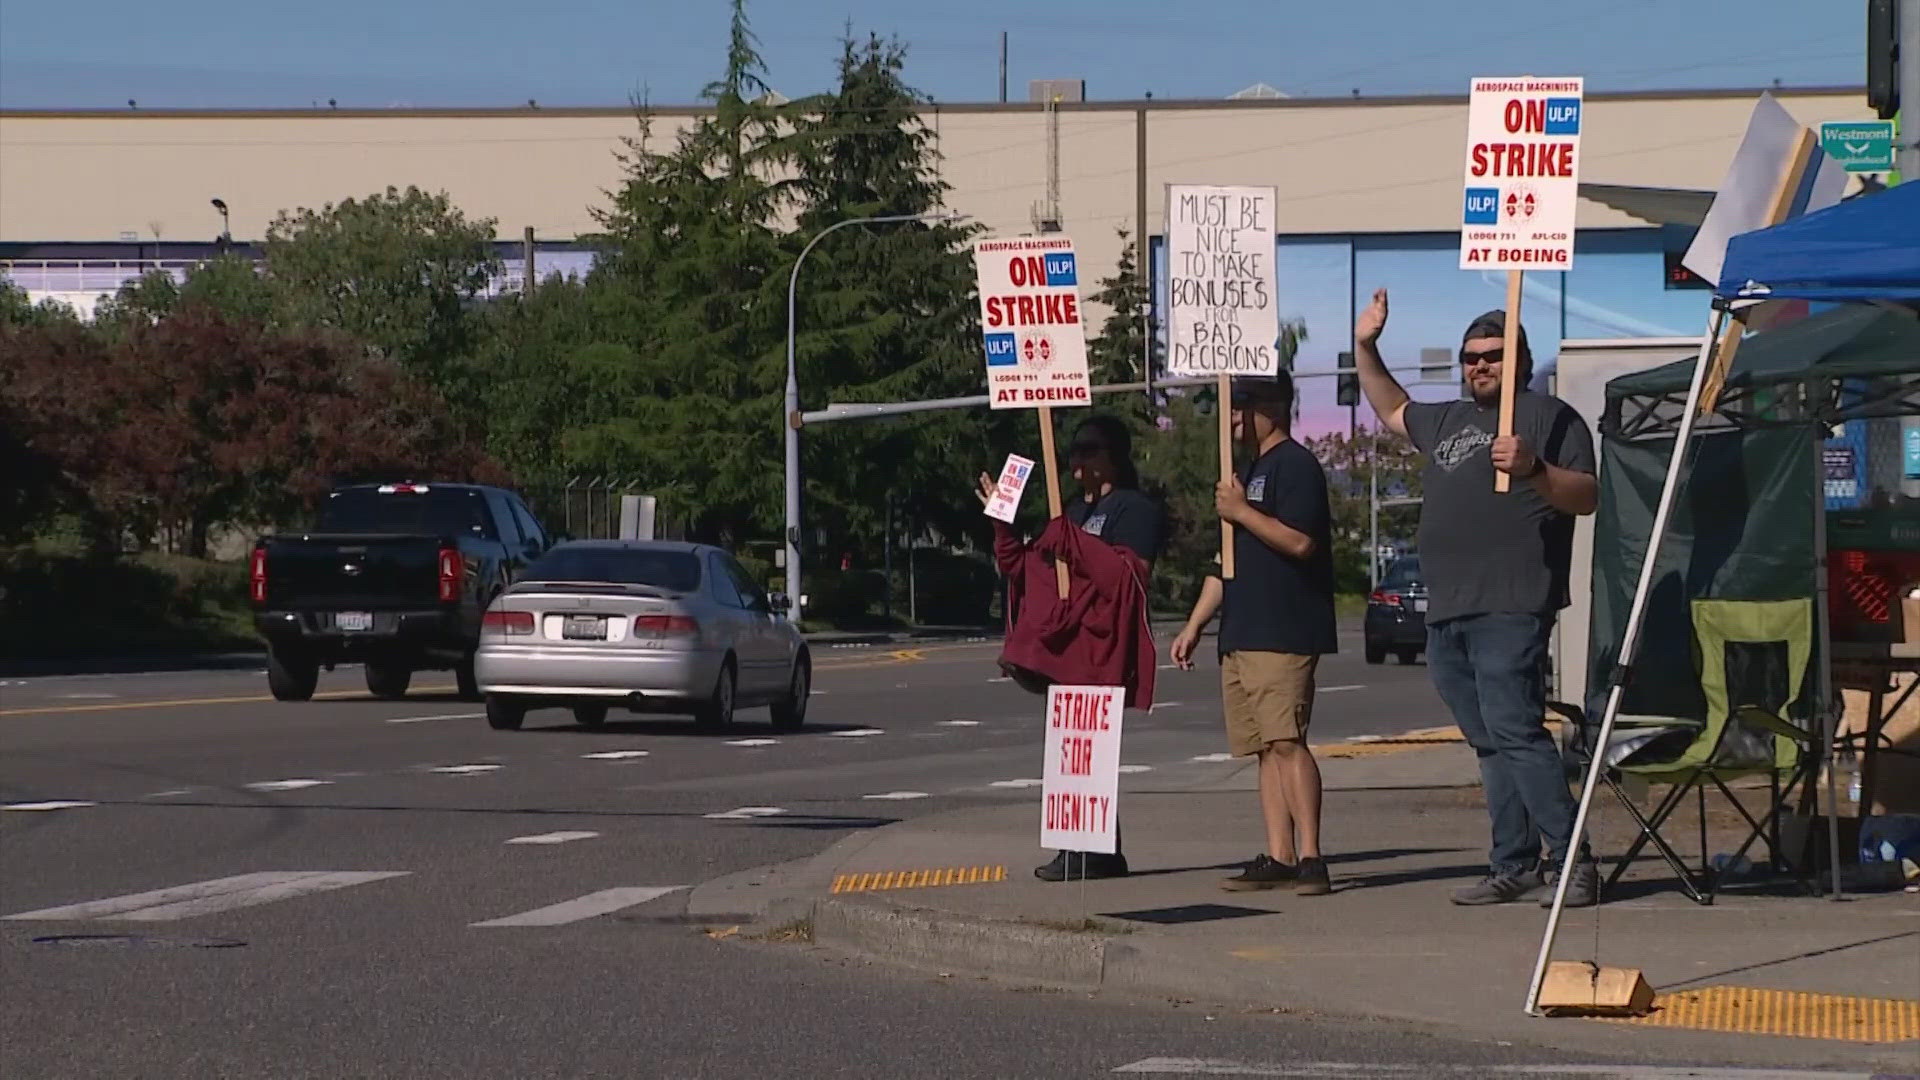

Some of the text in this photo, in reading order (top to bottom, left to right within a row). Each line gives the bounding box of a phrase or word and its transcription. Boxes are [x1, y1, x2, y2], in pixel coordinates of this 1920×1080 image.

[1475, 83, 1579, 92] AEROSPACE MACHINISTS
[1504, 99, 1577, 134] ON ULP!
[1824, 128, 1889, 140] Westmont
[1471, 143, 1574, 177] STRIKE
[1180, 194, 1267, 232] MUST BE
[1467, 196, 1495, 211] ULP!
[979, 239, 1071, 252] AEROSPACE MACHINISTS
[1196, 227, 1243, 254] NICE
[1469, 232, 1497, 240] LODGE
[1531, 232, 1567, 240] AFL-CIO
[1181, 252, 1263, 281] TO MAKE
[1468, 249, 1567, 262] AT BOEING
[1009, 256, 1074, 287] ON ULP!
[986, 293, 1078, 326] STRIKE
[1205, 307, 1239, 323] FROM
[988, 339, 1014, 354] ULP!
[1194, 322, 1243, 346] BAD
[1174, 343, 1270, 372] DECISIONS
[997, 387, 1087, 402] AT BOEING
[1053, 692, 1112, 732] STRIKE
[1061, 737, 1092, 776] FOR
[1047, 793, 1109, 833] DIGNITY
